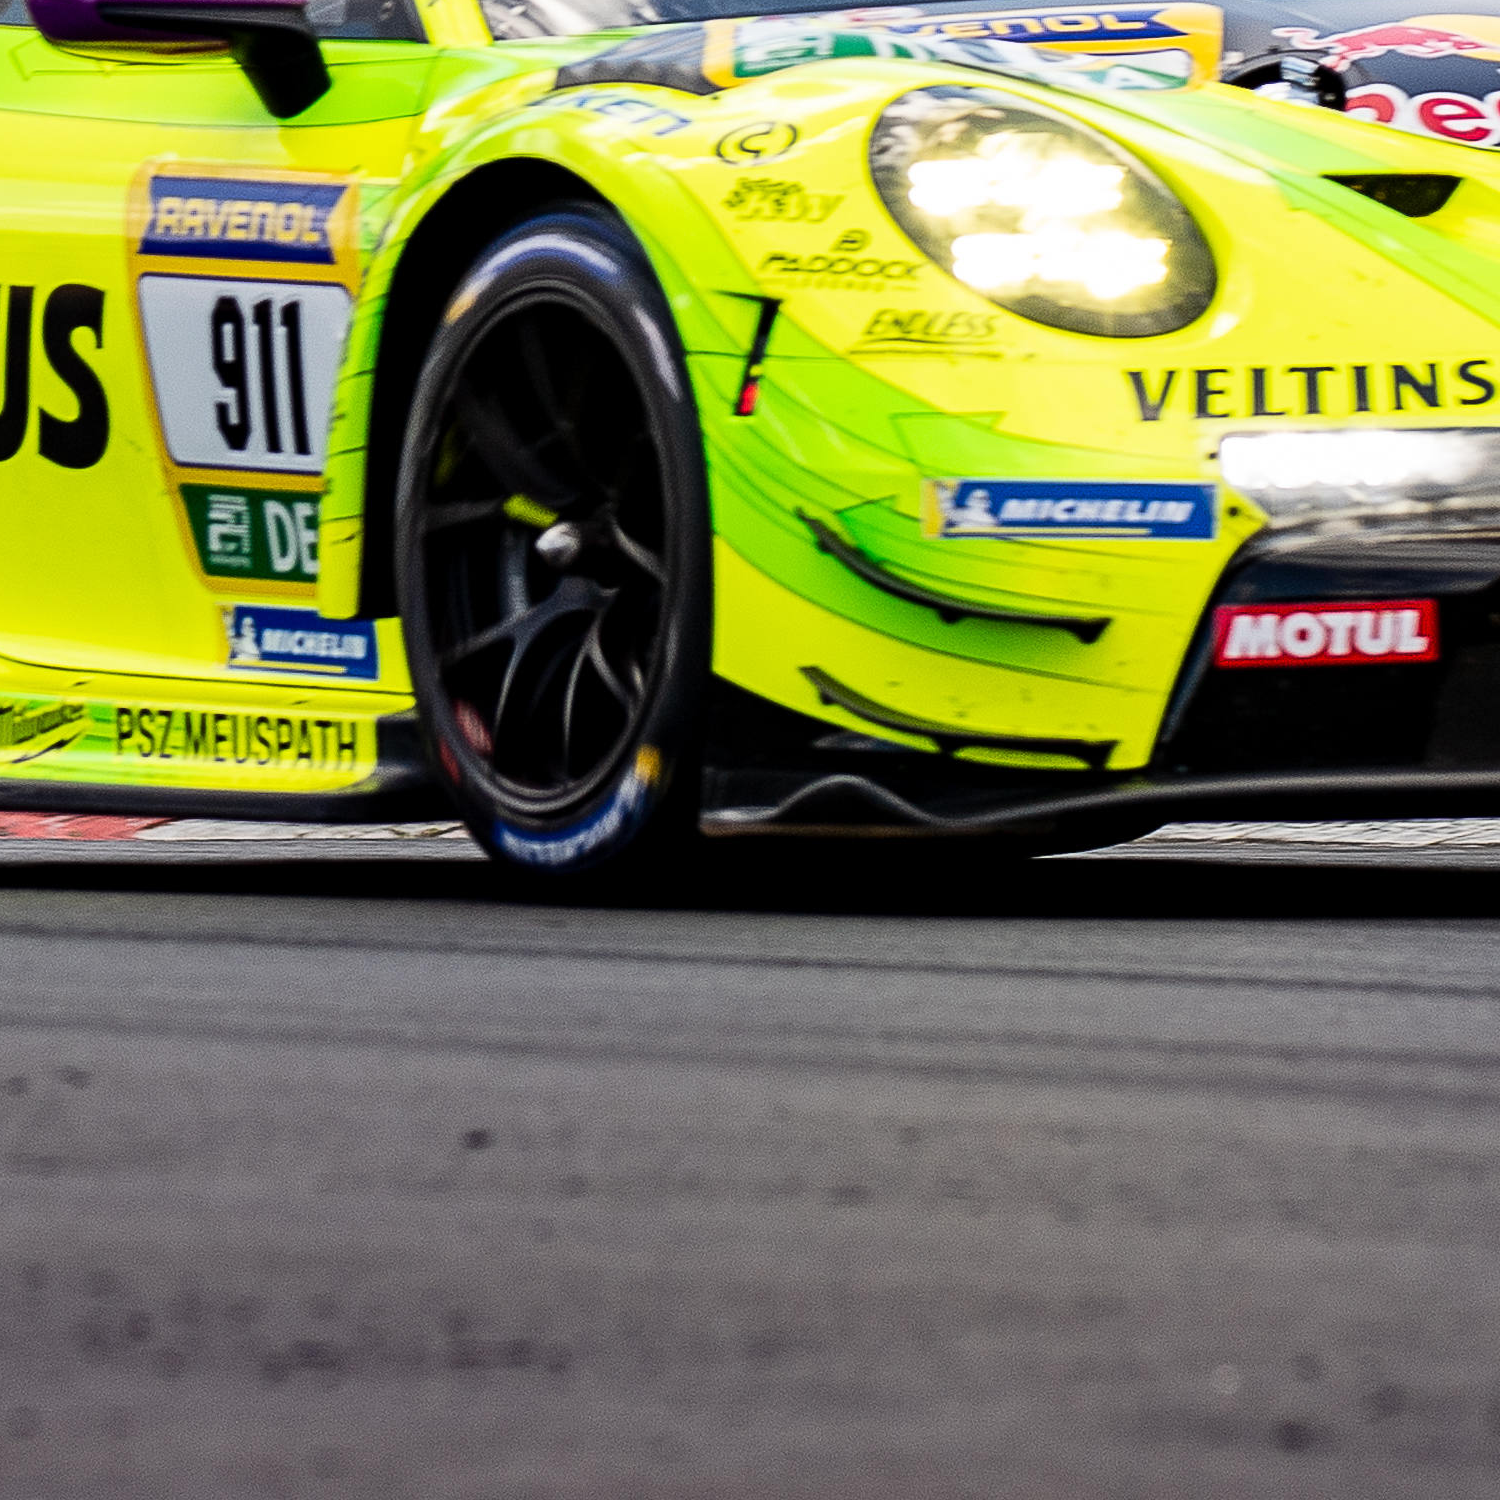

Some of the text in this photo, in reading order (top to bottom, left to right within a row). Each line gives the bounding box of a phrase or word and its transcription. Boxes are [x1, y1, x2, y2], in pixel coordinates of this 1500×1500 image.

[155, 195, 329, 248] RAVENOL
[210, 295, 314, 457] 911
[1127, 358, 1498, 423] VELTINS
[999, 496, 1196, 527] MICHELIN
[261, 627, 369, 660] MICHELIN
[1223, 607, 1430, 662] MOTUL
[182, 711, 358, 771] MEUSPATH
